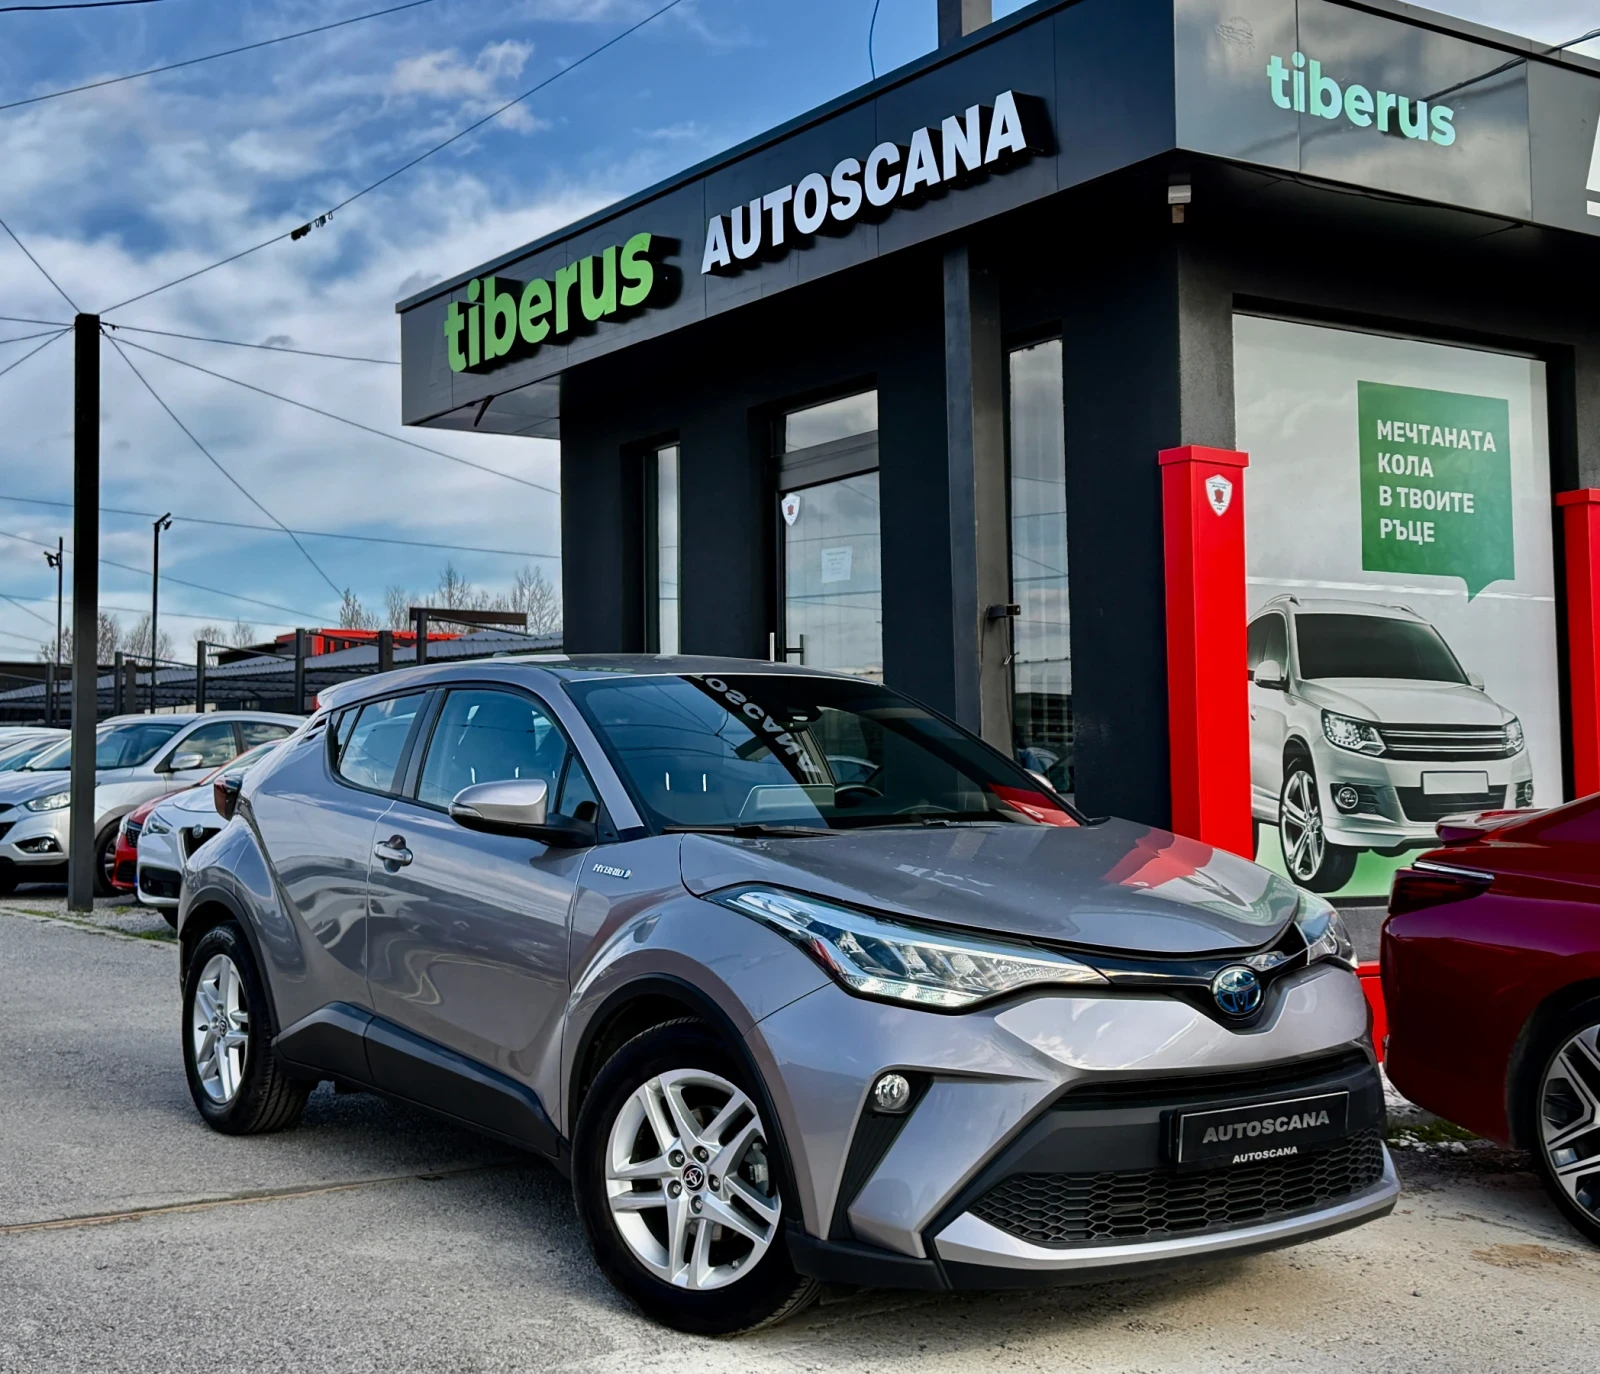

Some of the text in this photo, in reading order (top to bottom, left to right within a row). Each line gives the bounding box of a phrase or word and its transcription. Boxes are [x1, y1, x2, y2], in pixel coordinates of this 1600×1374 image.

[1266, 51, 1456, 147] tiberus
[444, 90, 1027, 373] tiberus AUTOSCANA
[1377, 419, 1496, 452] МЕЧТАНАТА
[1378, 452, 1434, 478] КОЛА
[1379, 485, 1475, 513] В ТВОИТЕ
[1380, 518, 1435, 545] РЪЦЕ
[1202, 1110, 1330, 1144] AUTOSCANA
[1232, 1146, 1298, 1164] AUTOSCANA
